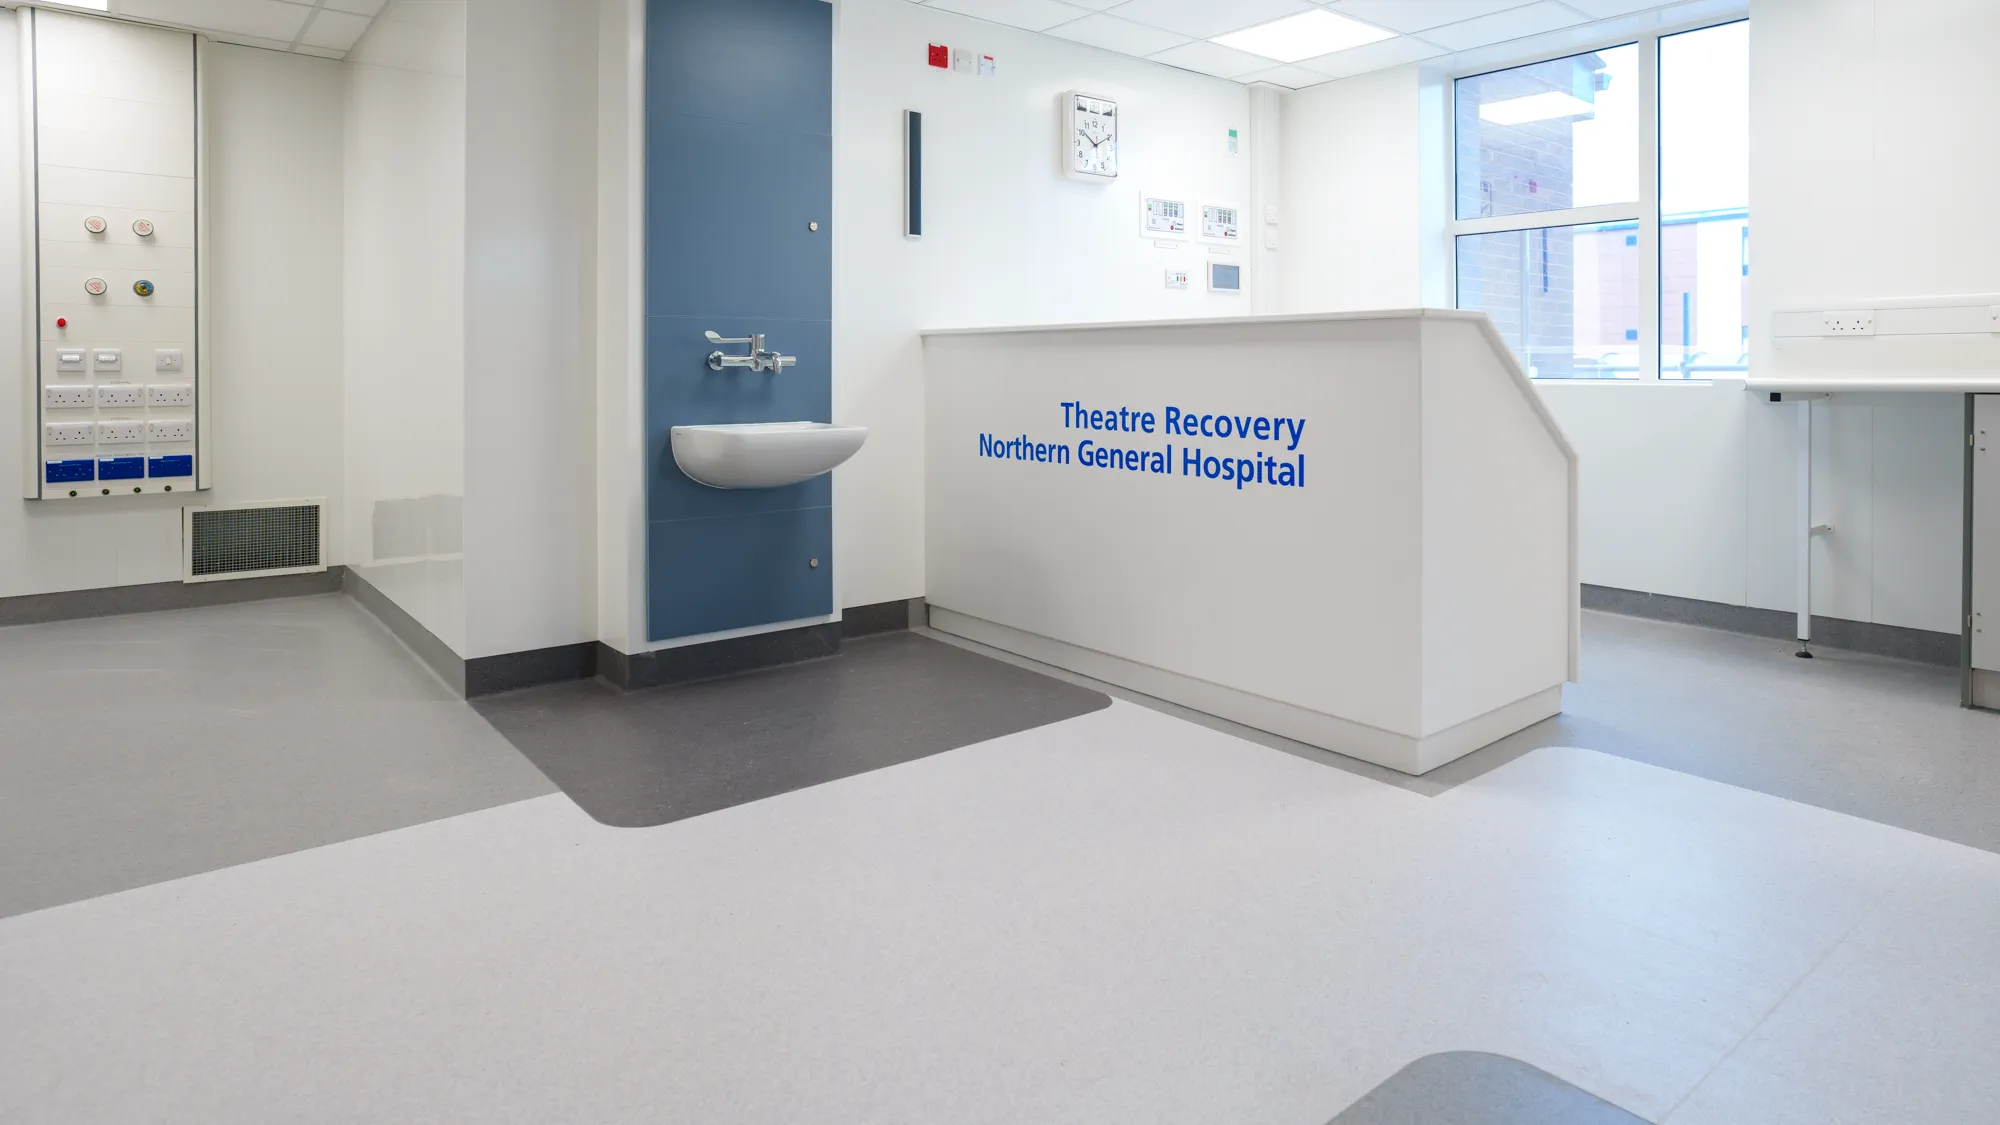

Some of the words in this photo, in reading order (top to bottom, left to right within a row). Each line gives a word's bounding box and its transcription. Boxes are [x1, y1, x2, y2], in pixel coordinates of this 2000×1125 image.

[1092, 120, 1098, 128] 12
[1060, 401, 1155, 433] Theatre
[1165, 406, 1305, 450] Recovery
[979, 433, 1070, 464] Northern
[1078, 440, 1172, 474] General
[1183, 447, 1305, 490] Hospital
